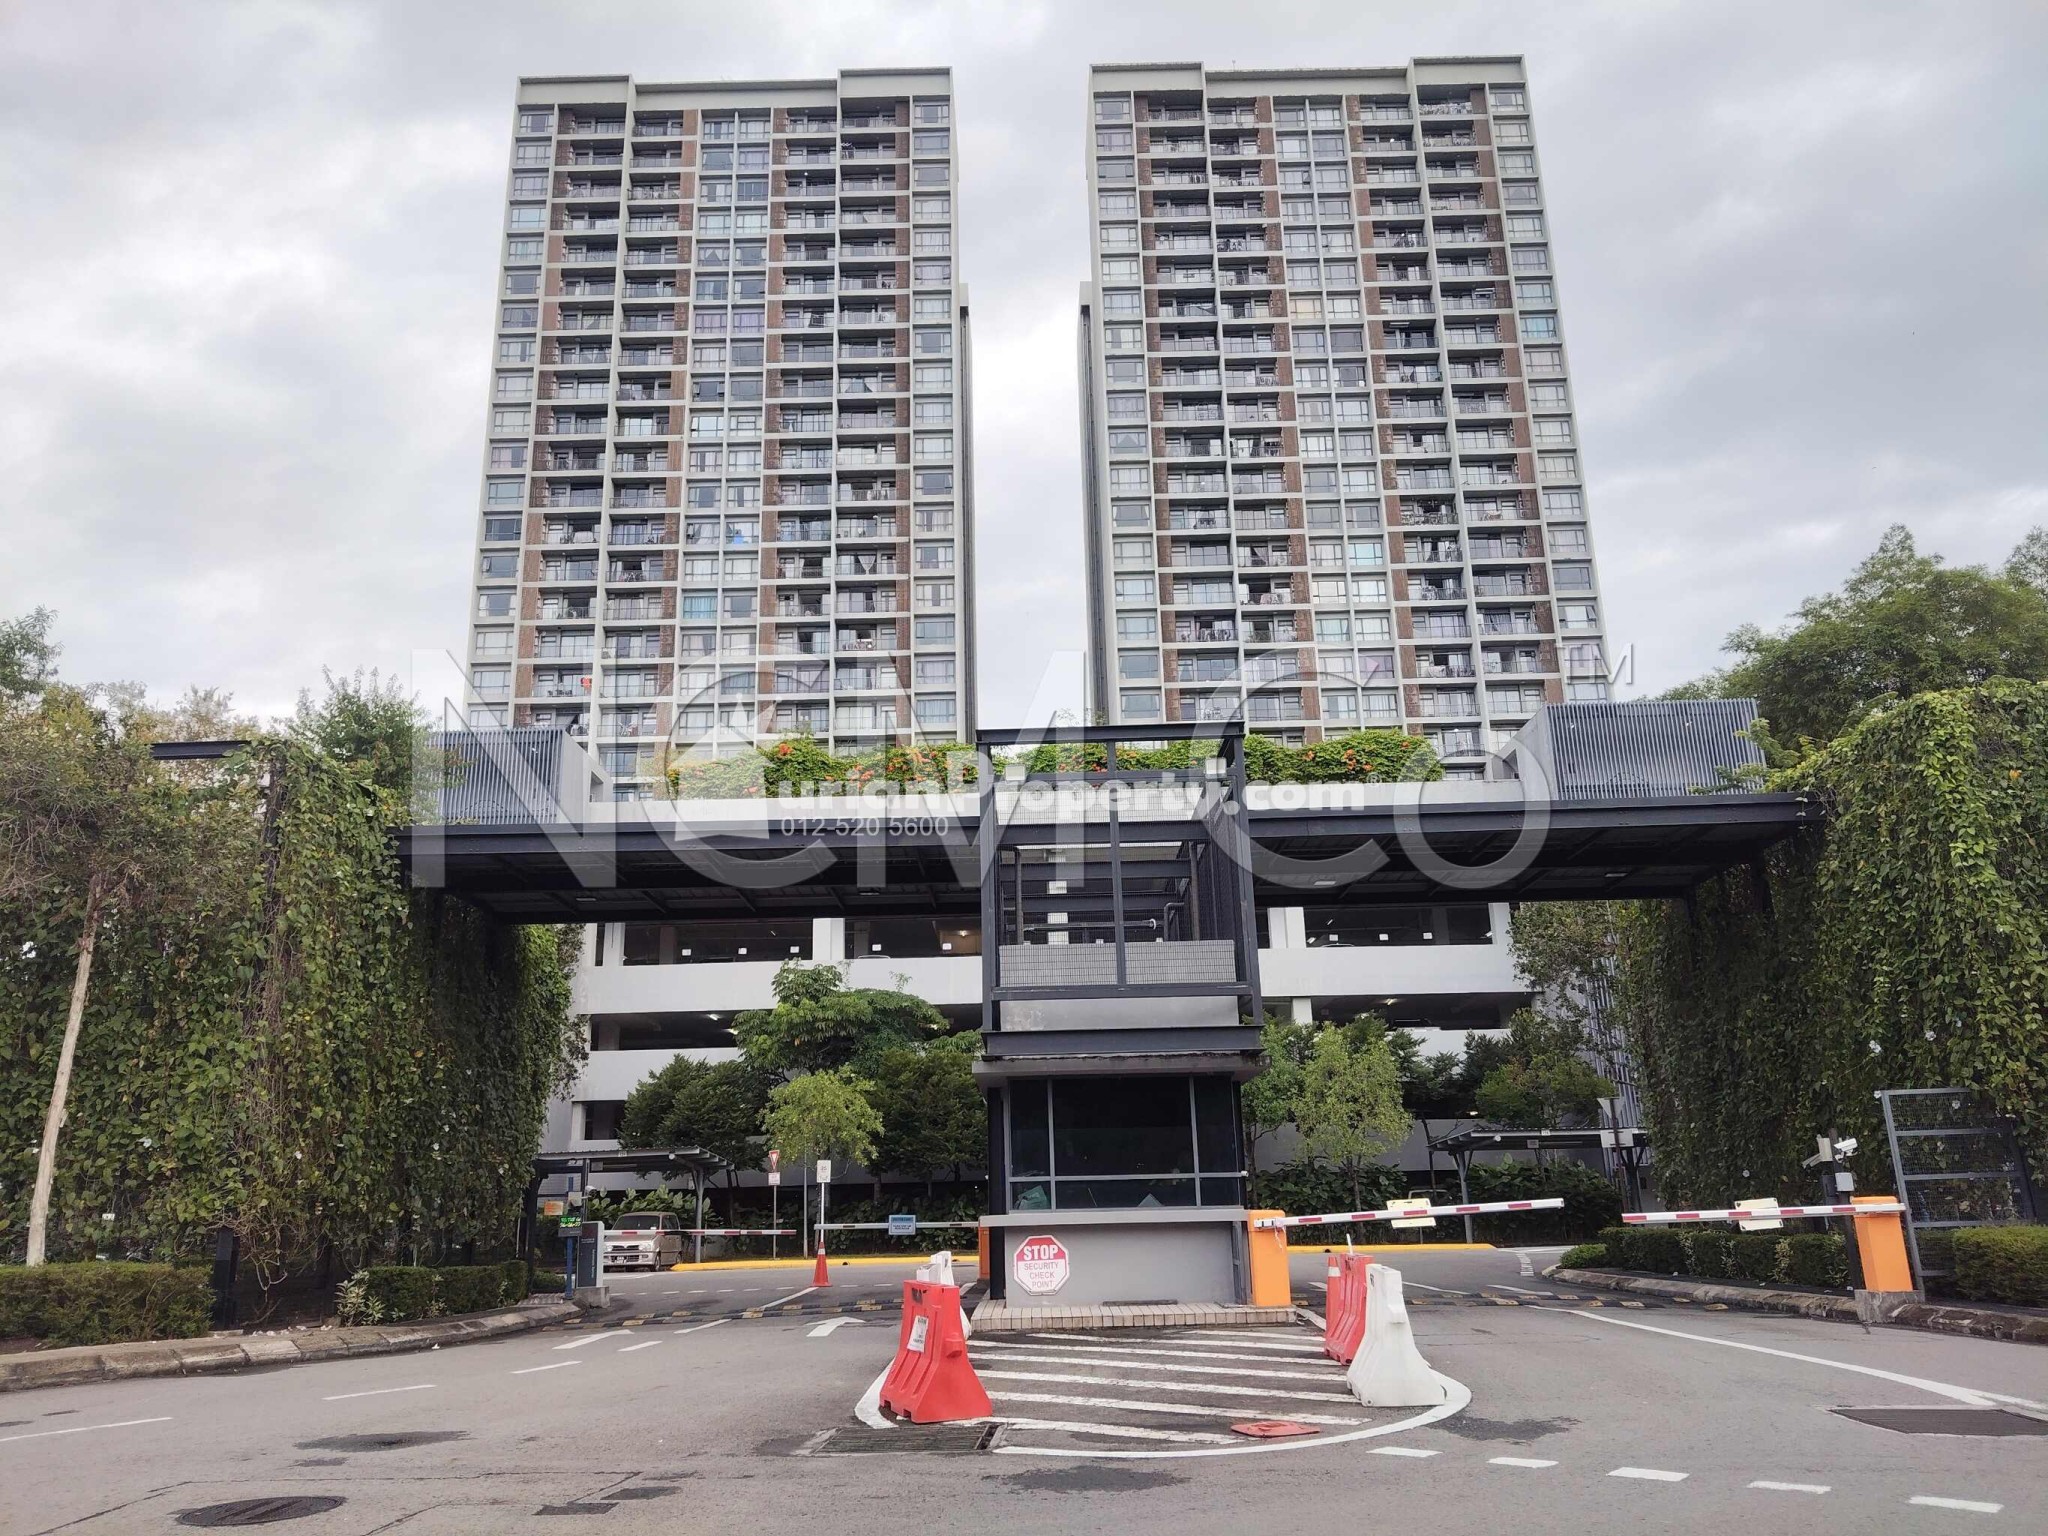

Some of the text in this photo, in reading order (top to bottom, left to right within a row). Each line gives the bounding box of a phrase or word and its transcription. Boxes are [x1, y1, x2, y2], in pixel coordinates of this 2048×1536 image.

[1024, 1245, 1058, 1260] STOP
[1025, 1262, 1059, 1271] SECURITY
[1030, 1271, 1055, 1279] CHECK
